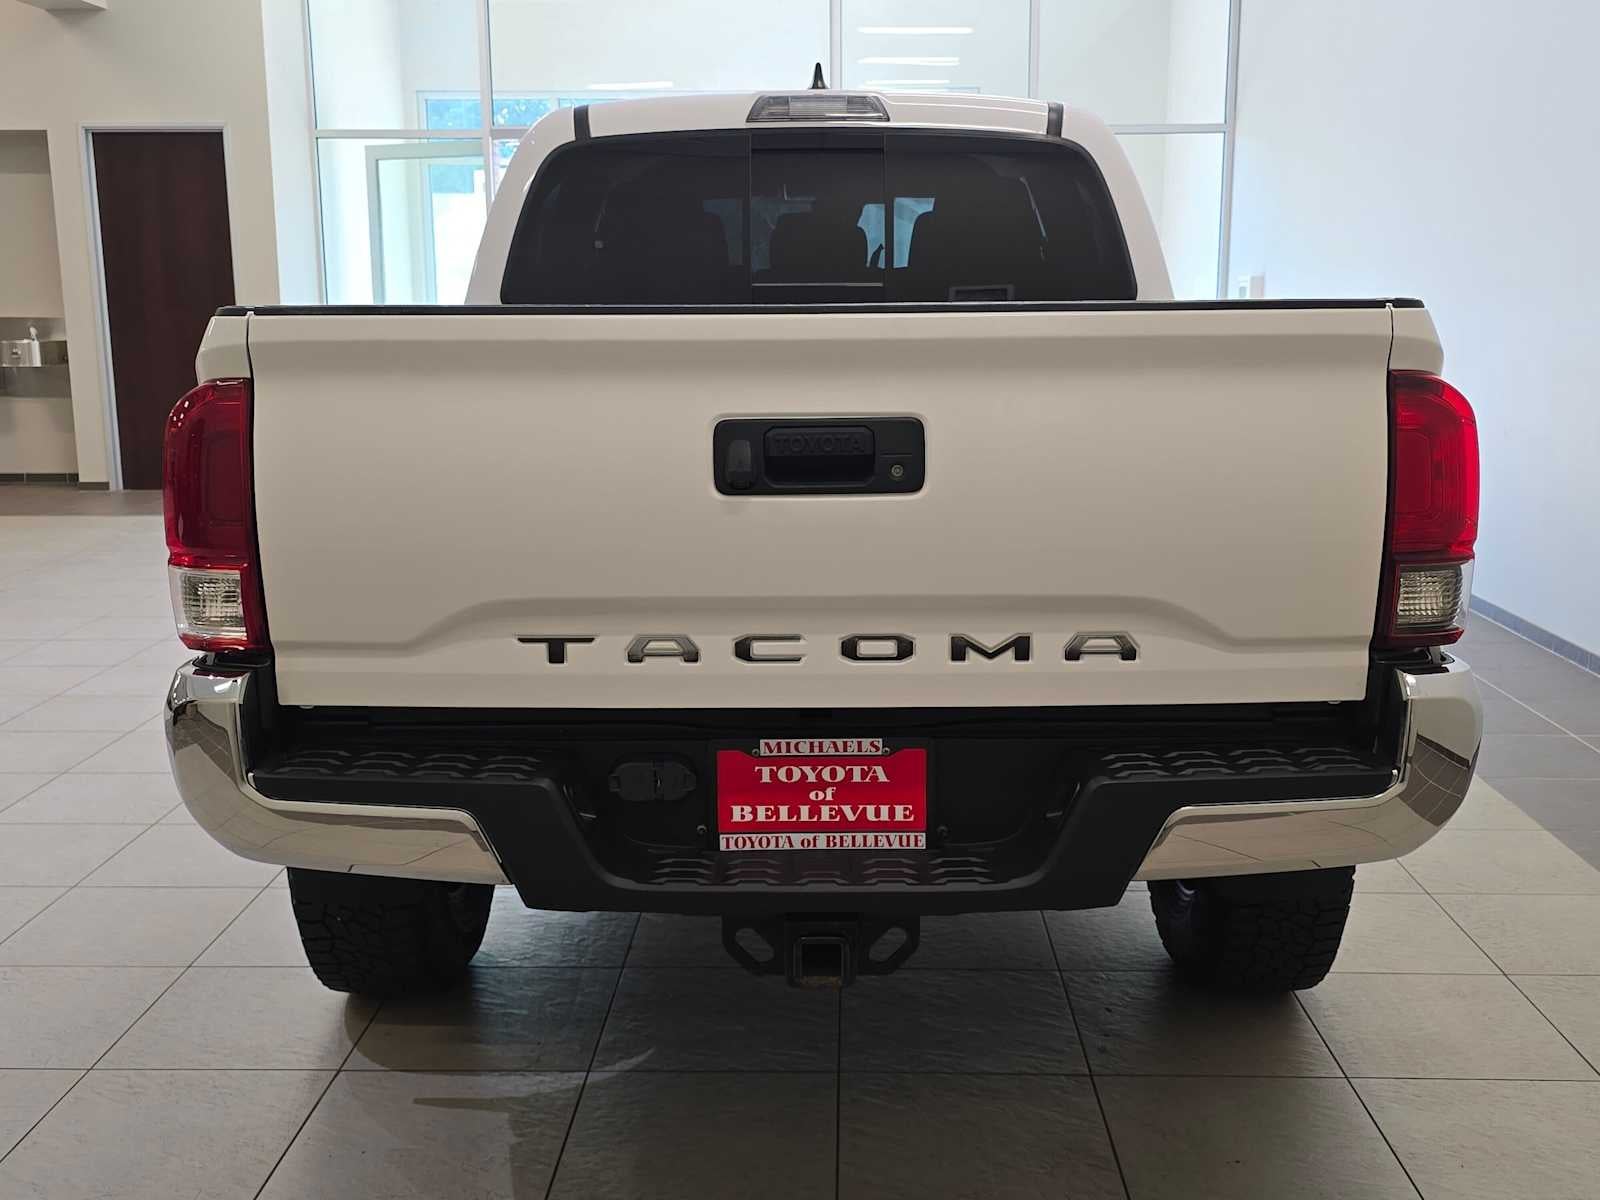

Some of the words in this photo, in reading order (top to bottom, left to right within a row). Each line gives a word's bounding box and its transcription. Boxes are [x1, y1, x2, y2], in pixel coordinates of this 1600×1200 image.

[775, 434, 865, 451] TOYOTA
[515, 632, 1139, 664] TACOMA
[763, 740, 881, 754] MICHAELS
[754, 765, 890, 783] TOYOTA
[808, 786, 837, 801] of
[730, 804, 915, 823] BELLEVUE
[721, 835, 795, 850] TOYOTA
[800, 834, 820, 849] of
[825, 834, 925, 849] BELLEVUE
